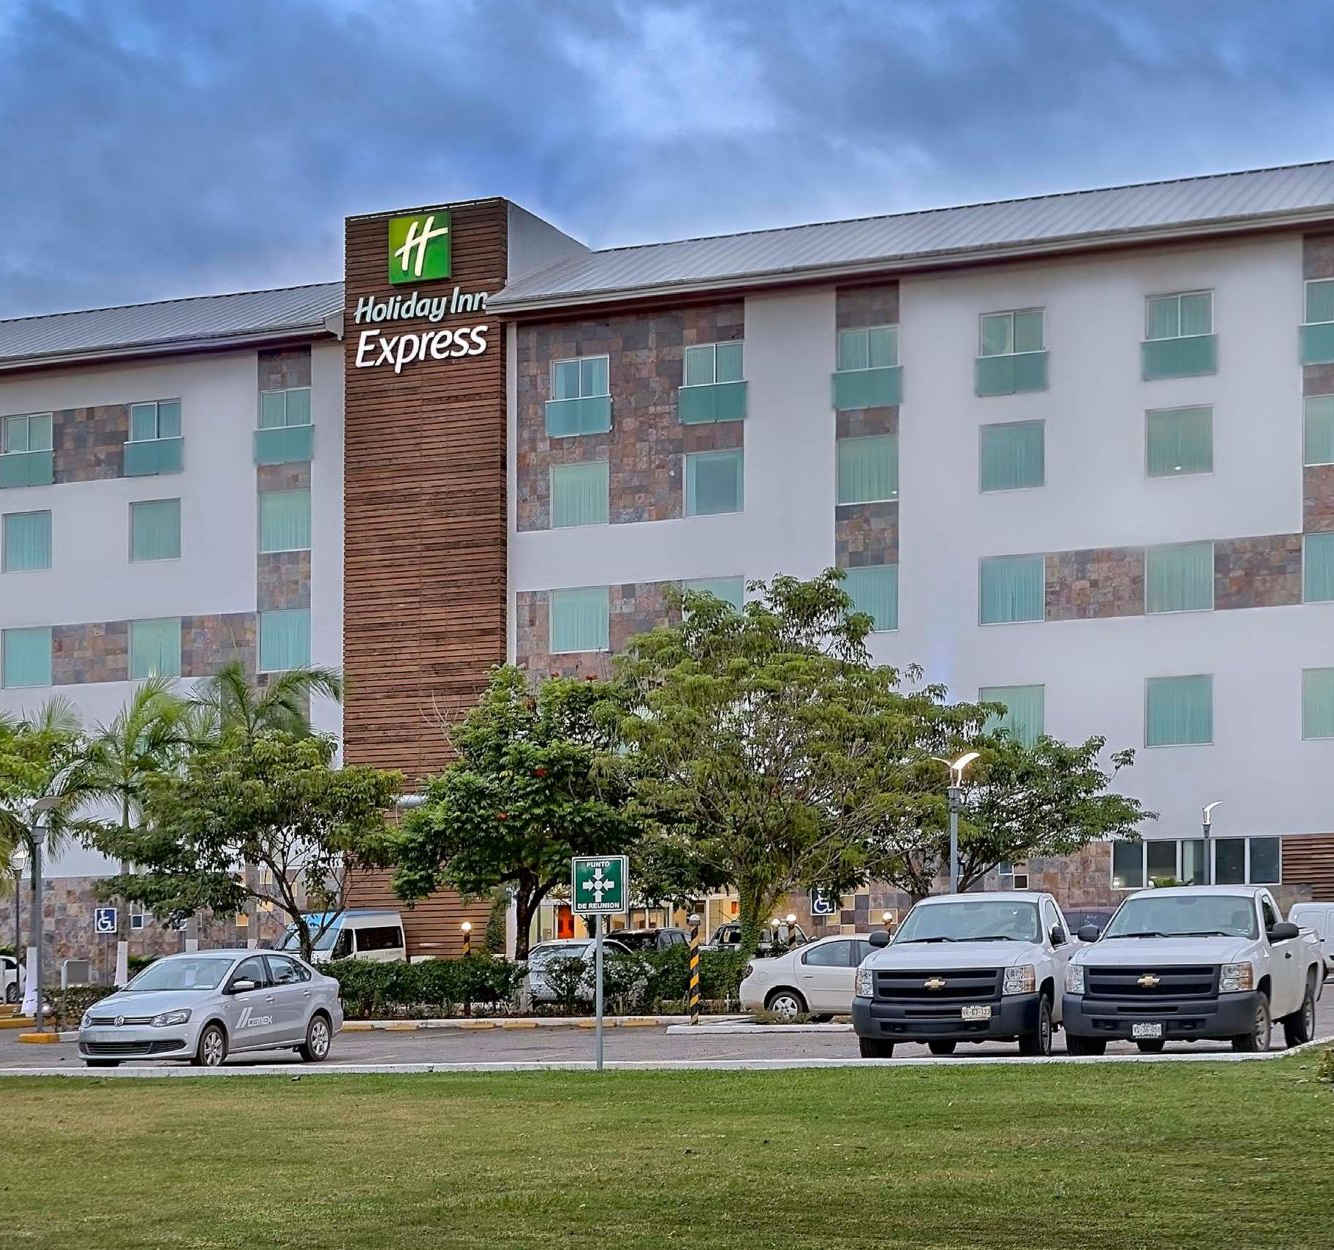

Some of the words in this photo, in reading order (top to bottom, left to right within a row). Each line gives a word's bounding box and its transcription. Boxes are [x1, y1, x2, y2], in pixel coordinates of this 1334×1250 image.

[394, 215, 449, 277] H
[353, 291, 447, 323] Holiday
[450, 286, 488, 314] Inn
[355, 325, 489, 374] Express
[586, 860, 611, 868] PUNTO
